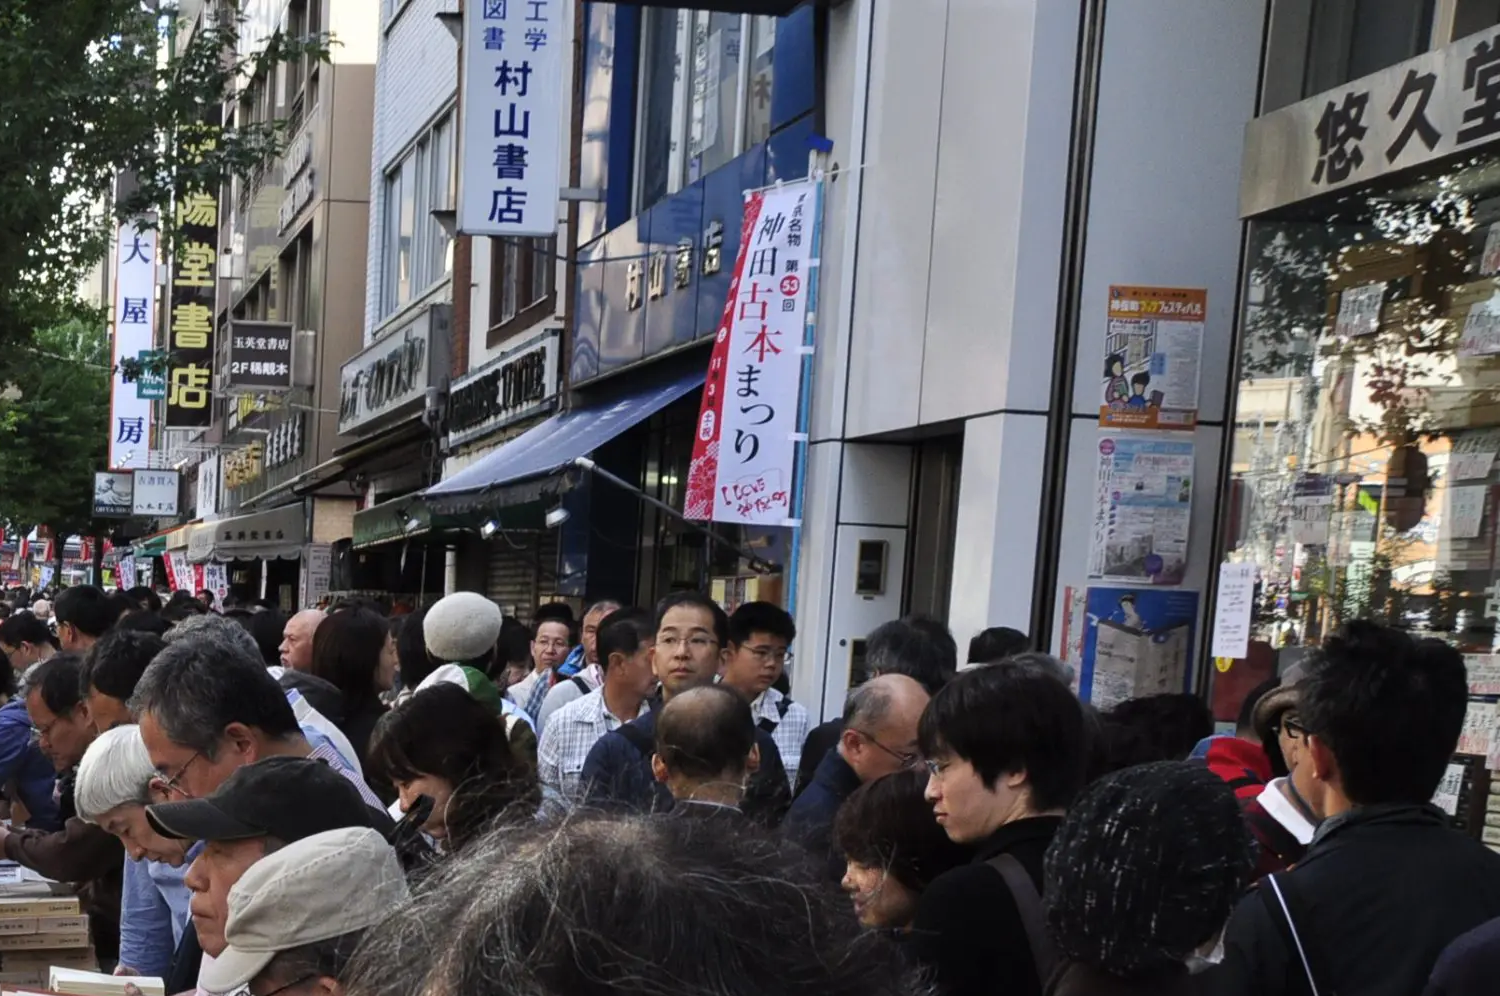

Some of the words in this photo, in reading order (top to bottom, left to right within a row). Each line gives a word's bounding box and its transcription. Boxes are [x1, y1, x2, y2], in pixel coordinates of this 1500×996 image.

[482, 0, 507, 51] 図書
[524, 1, 549, 51] 工学
[488, 60, 533, 224] 村山書店
[1311, 37, 1500, 185] 悠久堂
[116, 238, 150, 444] 大屋房
[233, 336, 289, 350] 玉英堂書店
[733, 212, 787, 464] 神田古本まつり
